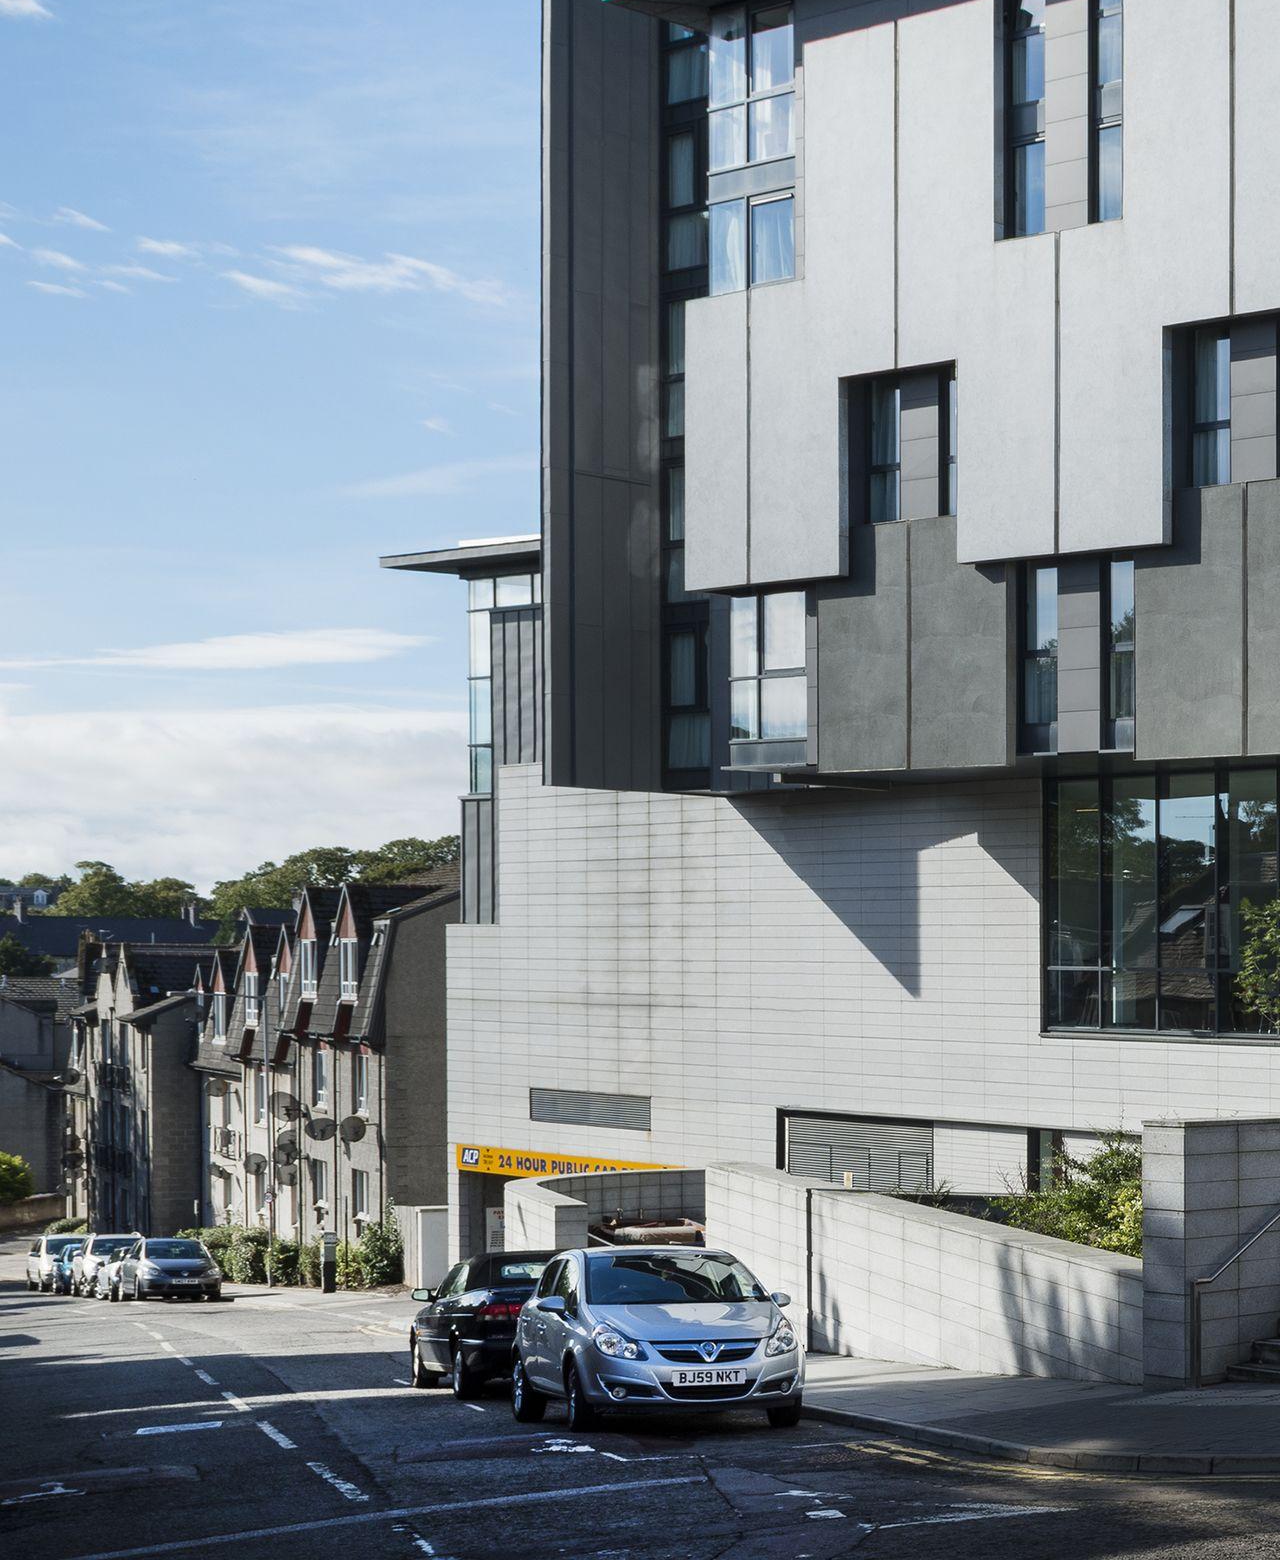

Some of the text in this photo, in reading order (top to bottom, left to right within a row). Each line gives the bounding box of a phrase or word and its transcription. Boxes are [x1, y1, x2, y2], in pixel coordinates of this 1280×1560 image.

[462, 1149, 479, 1165] ACP
[498, 1154, 512, 1169] 24
[516, 1156, 547, 1173] HOUR
[551, 1160, 590, 1174] PUBLIC
[679, 1370, 741, 1384] BJ59 NKT
